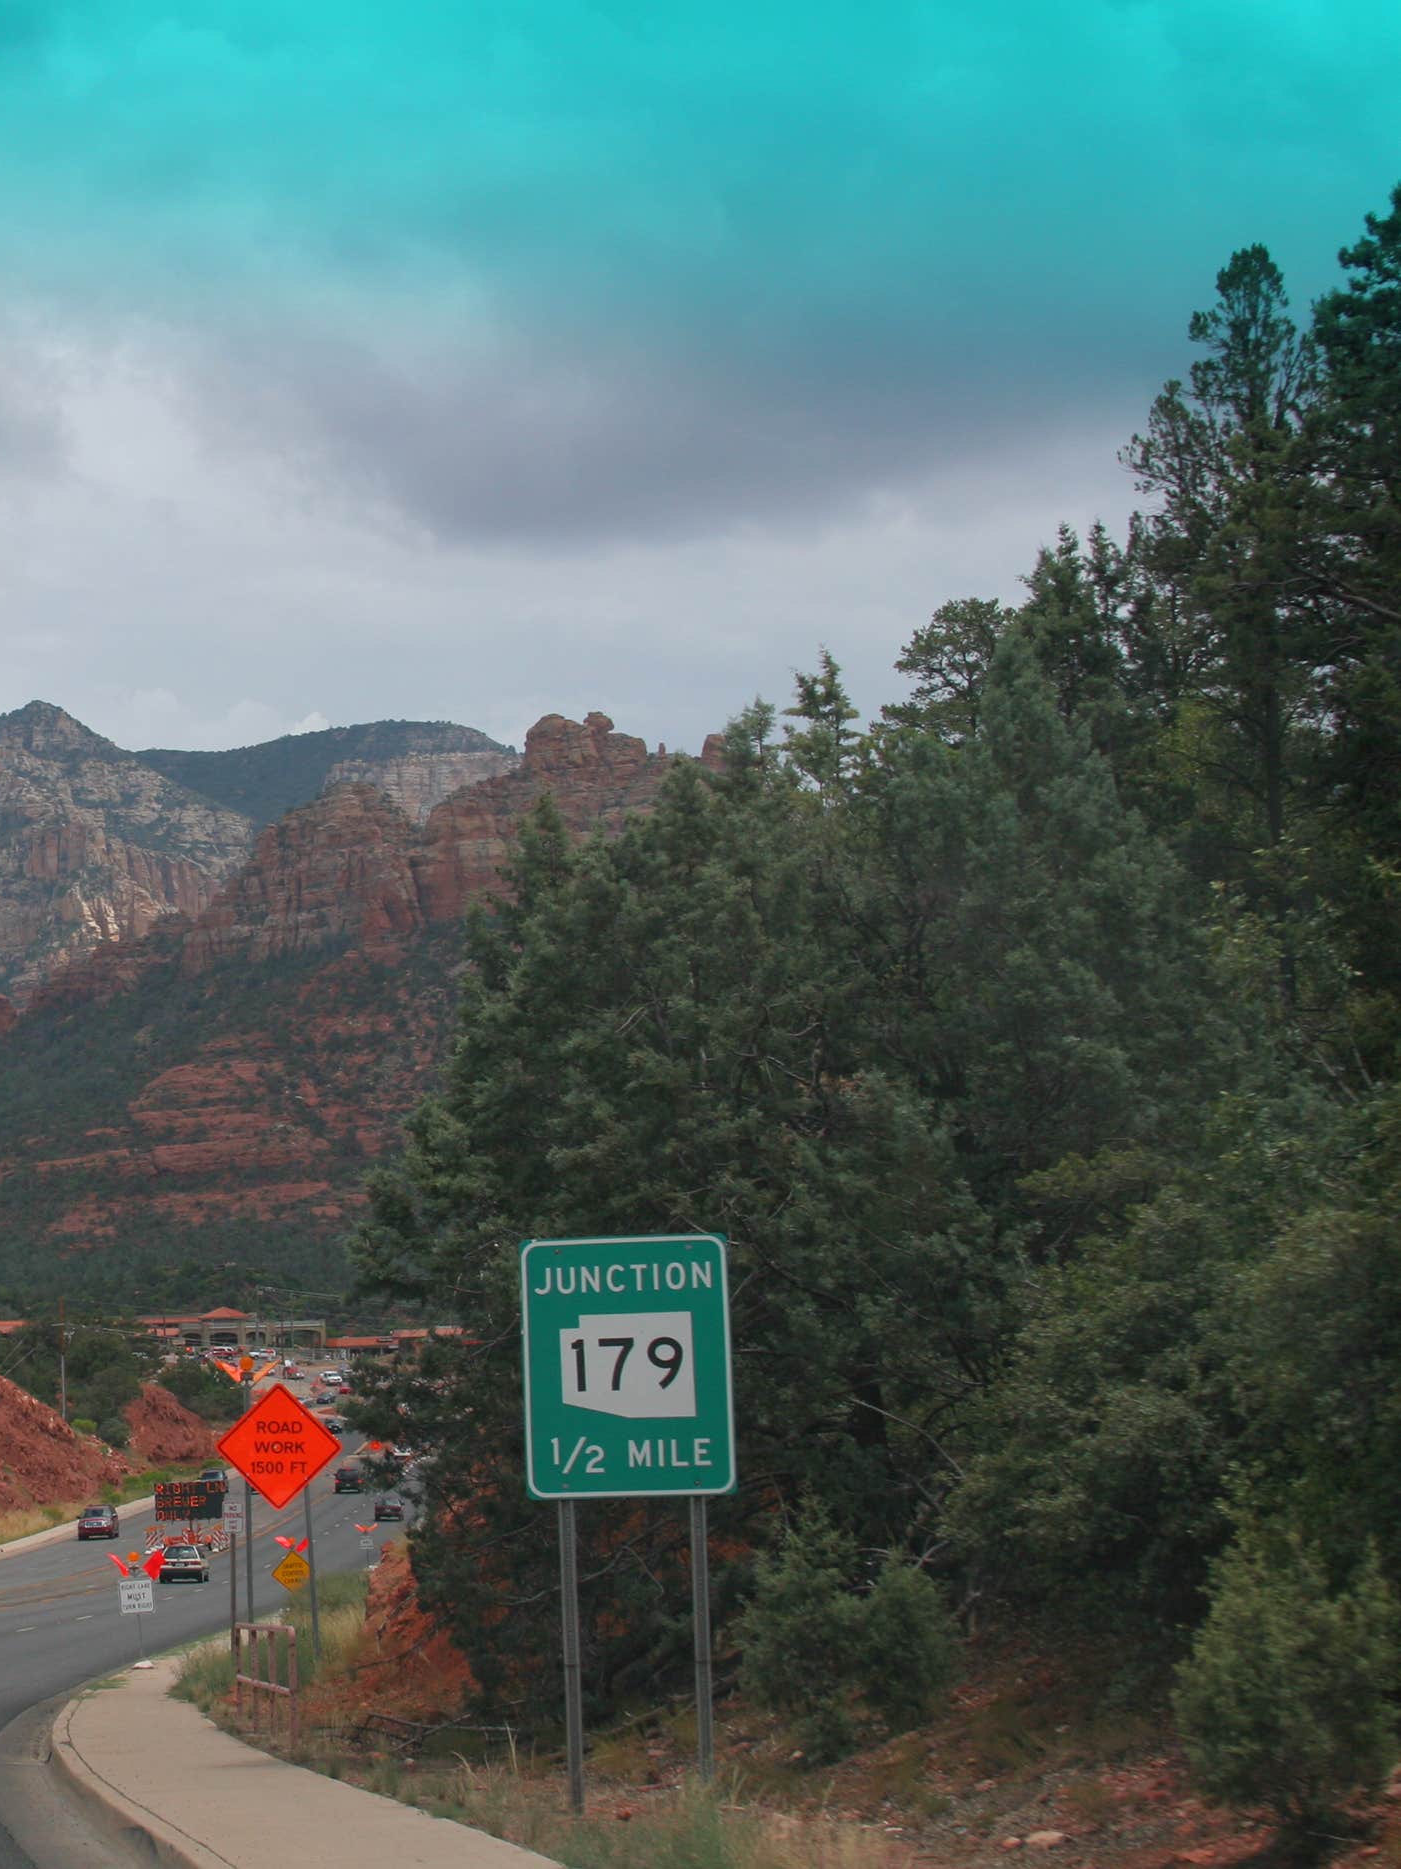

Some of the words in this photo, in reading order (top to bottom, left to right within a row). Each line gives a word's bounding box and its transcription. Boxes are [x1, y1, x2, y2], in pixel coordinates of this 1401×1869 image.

[534, 1261, 713, 1295] JUNCTION
[571, 1336, 684, 1392] 179
[256, 1420, 303, 1434] ROAD
[254, 1440, 306, 1454] WORK
[551, 1436, 606, 1475] 1/2
[628, 1438, 713, 1468] MILE
[251, 1461, 284, 1475] 1500
[290, 1461, 308, 1474] FT
[156, 1482, 200, 1496] RIGHT
[206, 1481, 227, 1494] LN
[127, 1592, 146, 1601] MUST
